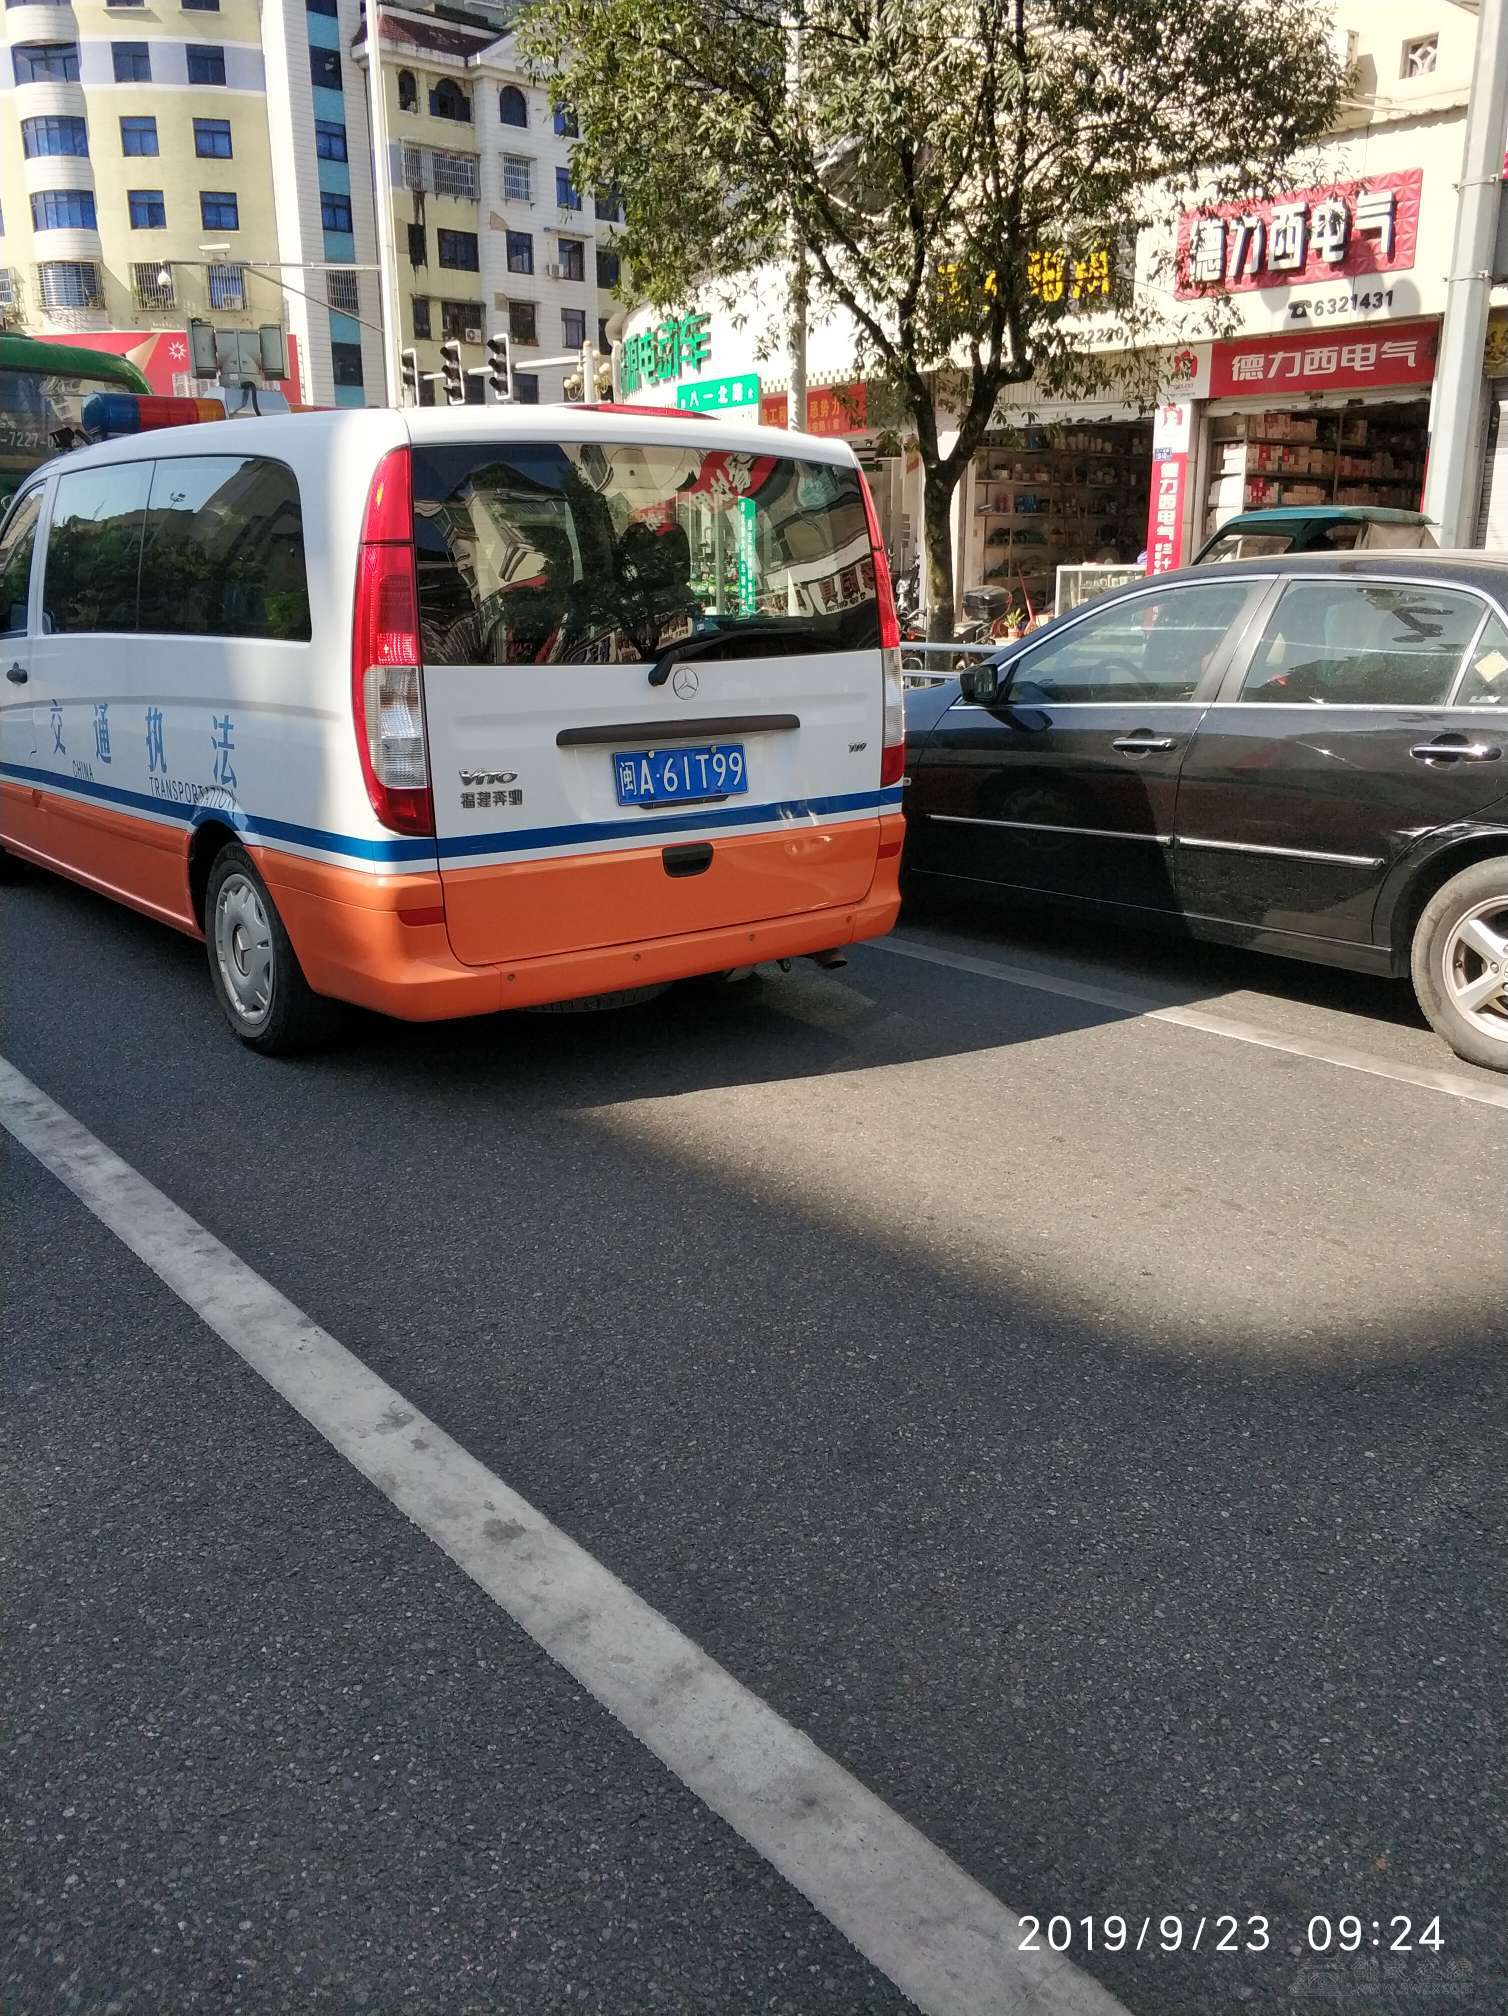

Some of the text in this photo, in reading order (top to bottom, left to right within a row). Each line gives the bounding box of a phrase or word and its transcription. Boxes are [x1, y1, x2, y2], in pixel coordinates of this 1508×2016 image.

[1189, 189, 1397, 283] 德力西电气
[1314, 290, 1394, 317] 6321431
[1231, 340, 1417, 382] 德力西电气
[49, 698, 238, 788] 交通执法
[72, 760, 94, 782] CHINA
